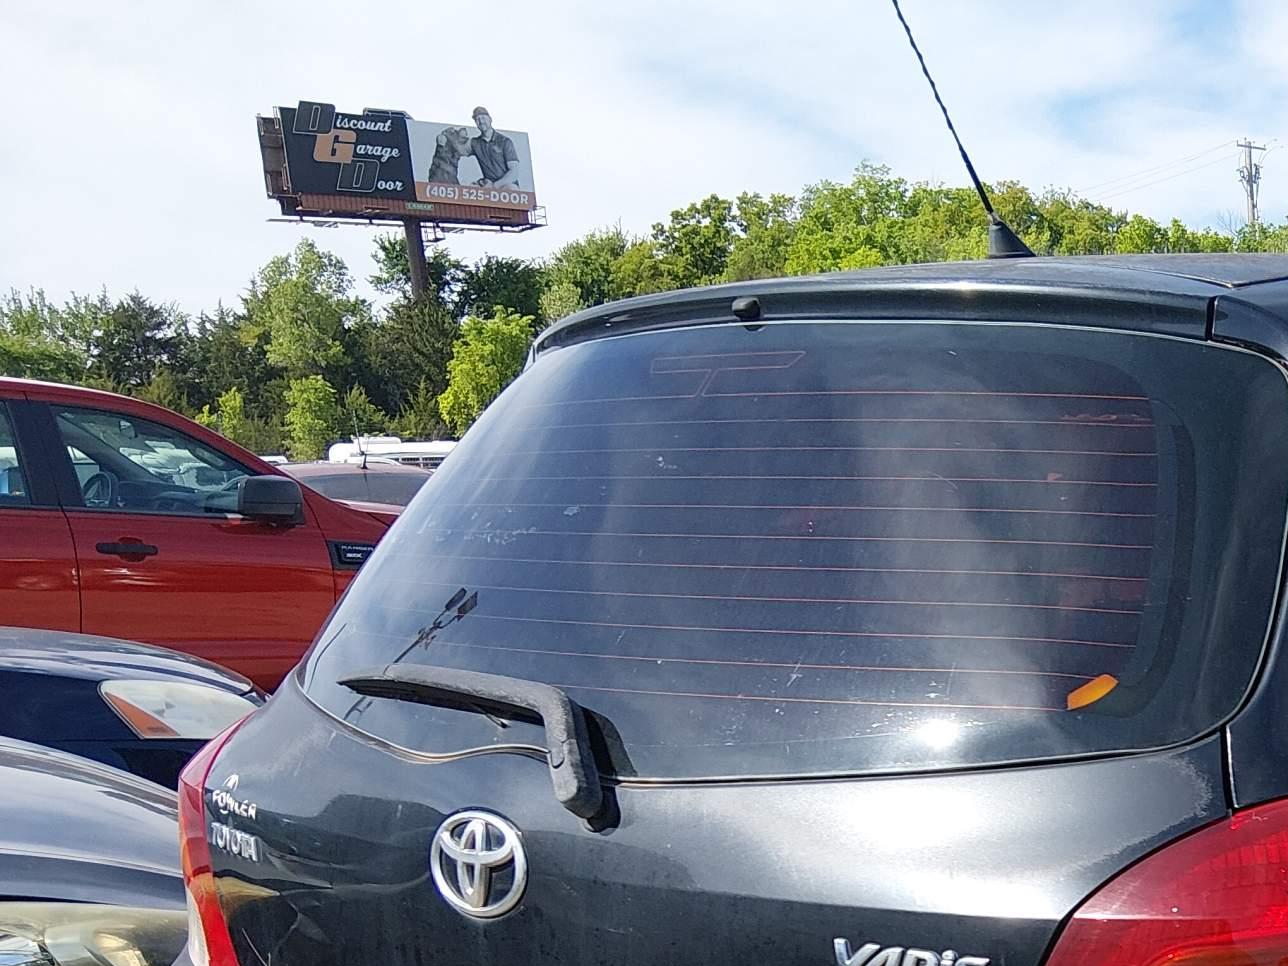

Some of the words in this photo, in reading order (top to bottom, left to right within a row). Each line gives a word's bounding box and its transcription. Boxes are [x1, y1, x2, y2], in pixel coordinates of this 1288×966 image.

[293, 100, 392, 135] Discount
[313, 128, 401, 164] Garage
[336, 157, 405, 193] Door
[426, 184, 459, 200] (405)
[462, 188, 529, 205] 525-DOOR
[211, 822, 258, 863] TOYOTA
